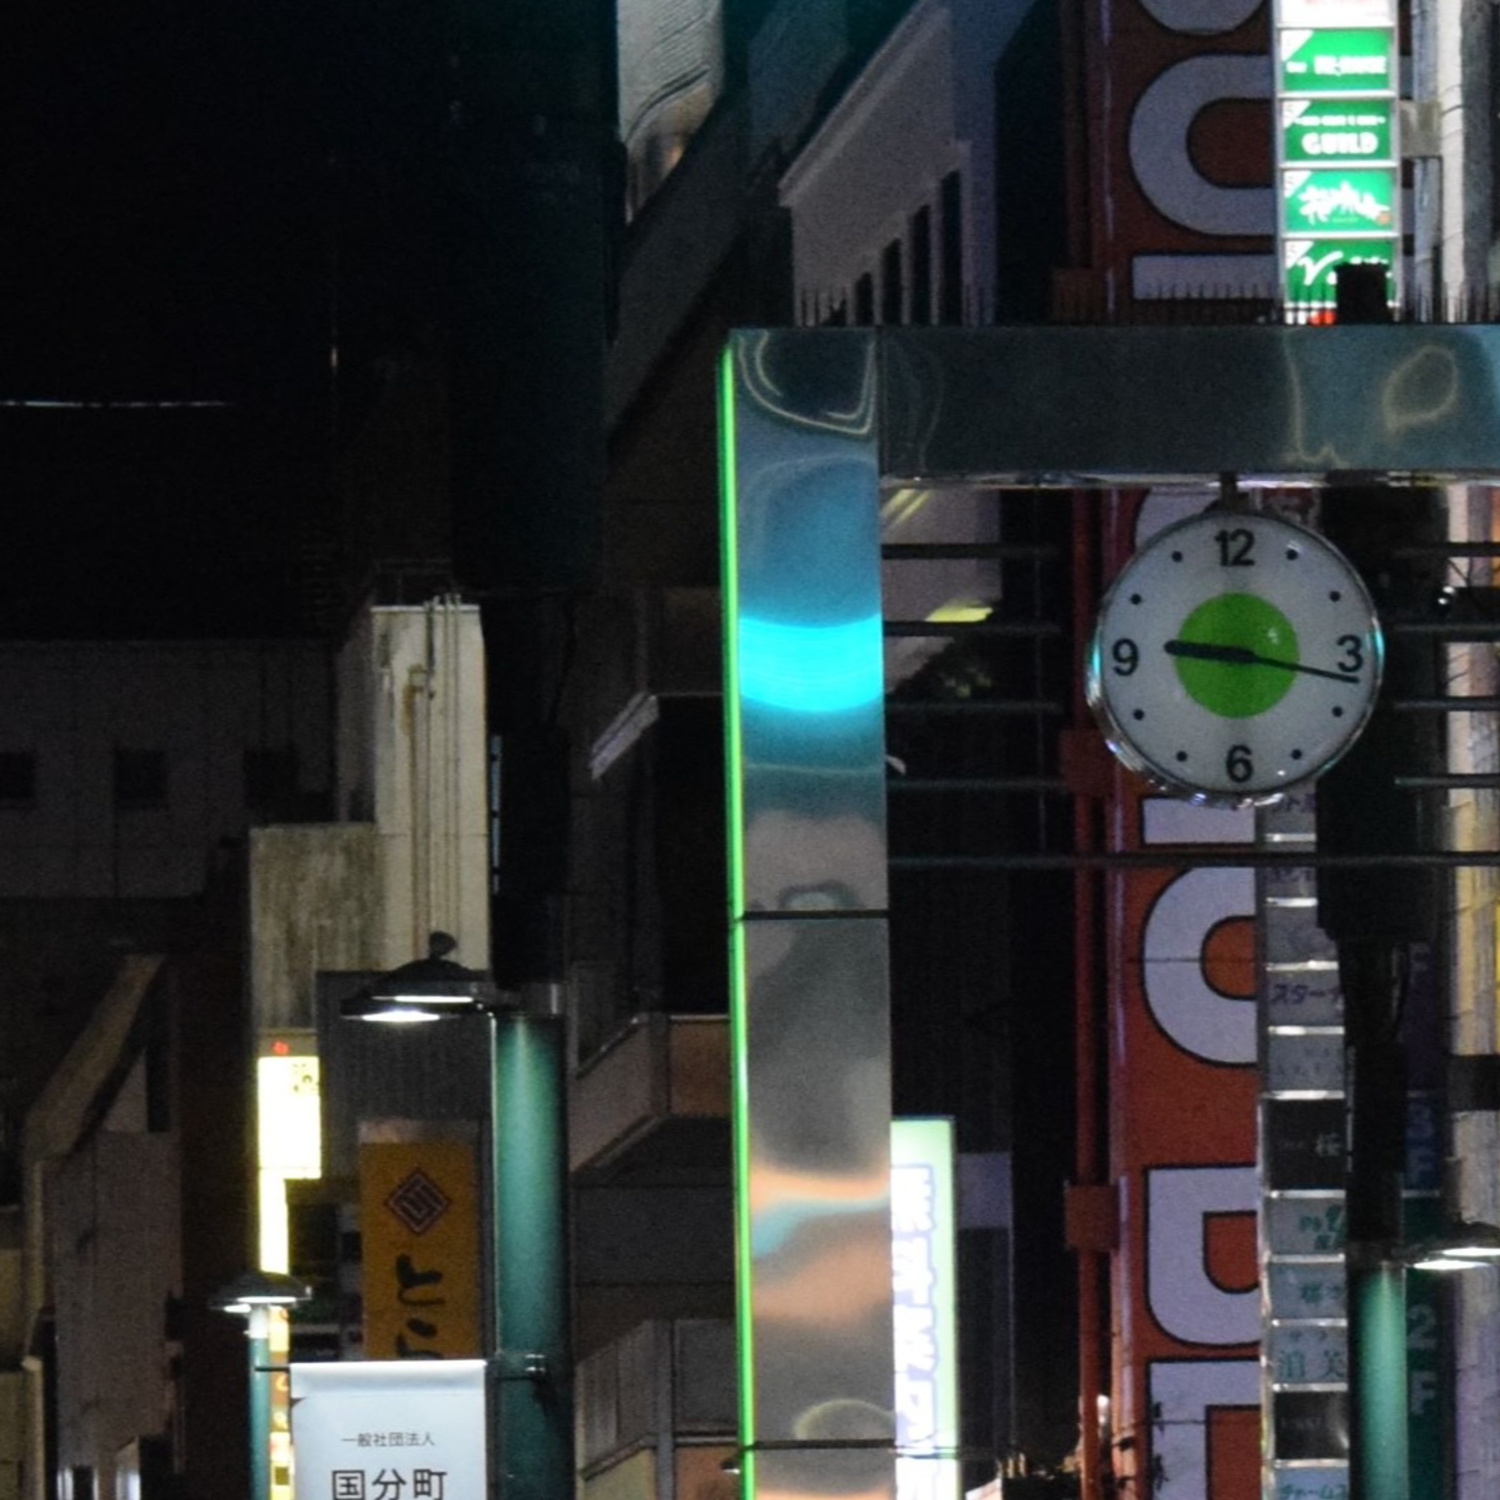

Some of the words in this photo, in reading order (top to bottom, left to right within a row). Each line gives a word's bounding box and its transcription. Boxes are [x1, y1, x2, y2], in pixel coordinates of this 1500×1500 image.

[1214, 528, 1255, 567] 12
[1112, 638, 1140, 677] 9
[1336, 634, 1363, 673] 3
[1226, 744, 1253, 783] 6
[341, 1432, 435, 1447] 一般社団法人
